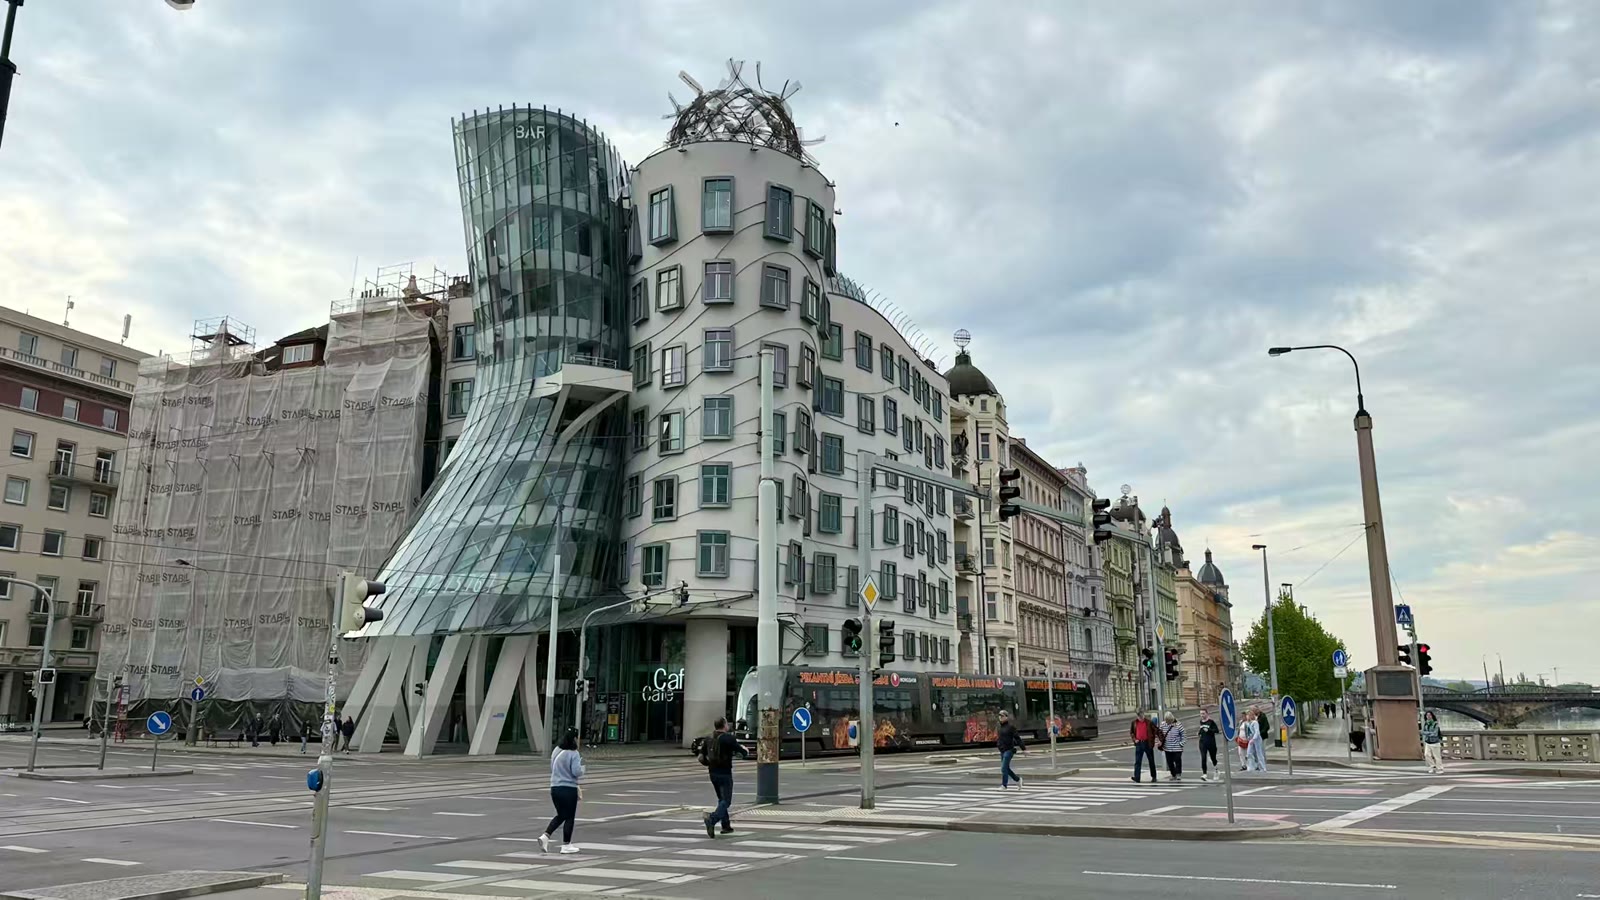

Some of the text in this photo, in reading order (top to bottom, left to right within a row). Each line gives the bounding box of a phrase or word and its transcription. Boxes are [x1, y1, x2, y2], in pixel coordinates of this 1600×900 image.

[515, 125, 545, 139] BAR
[318, 409, 340, 419] STAB
[309, 511, 331, 521] STAB
[298, 616, 329, 628] STABIL
[150, 664, 180, 675] STABIL
[653, 667, 685, 690] Caf
